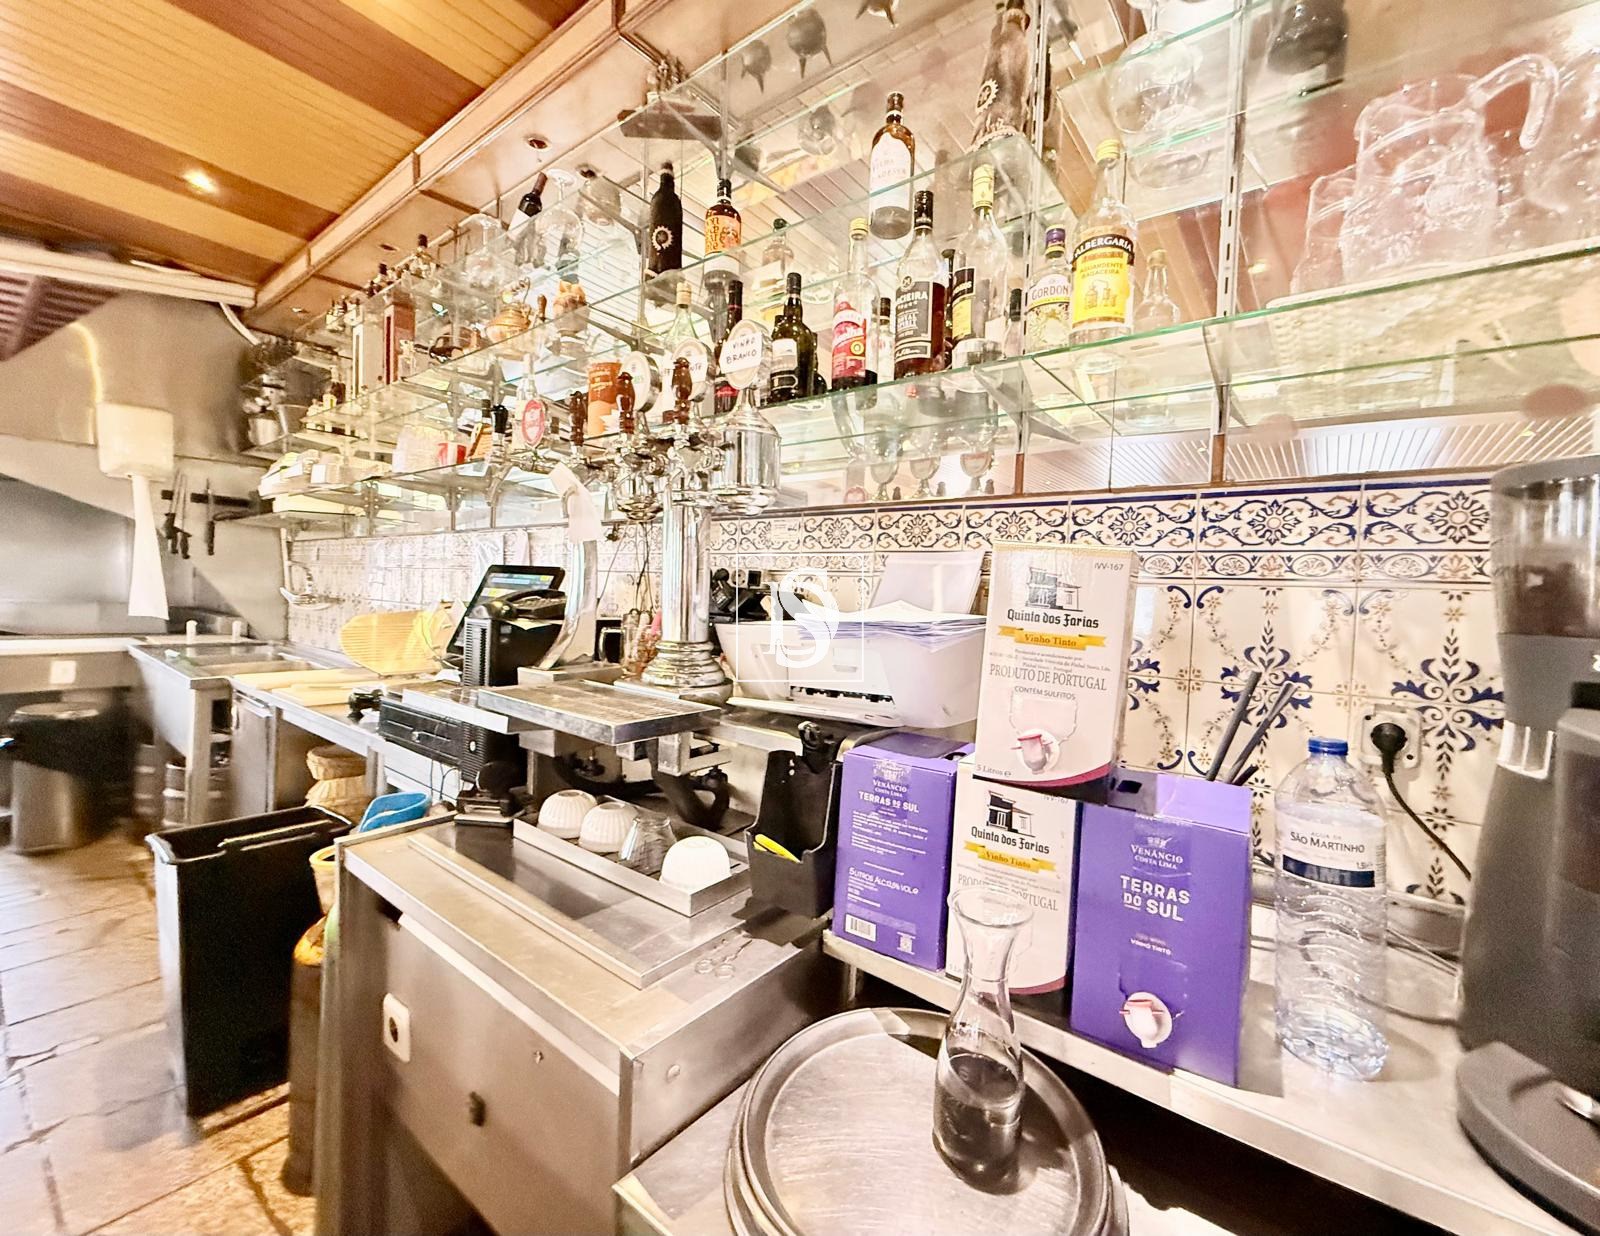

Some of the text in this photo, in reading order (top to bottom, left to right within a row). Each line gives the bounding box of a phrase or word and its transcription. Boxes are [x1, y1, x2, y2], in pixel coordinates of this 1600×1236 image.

[1074, 237, 1132, 257] ALBERGARIA
[726, 349, 757, 364] BRANCO
[1007, 608, 1099, 629] Quinta dos Farias
[1024, 634, 1077, 647] Vinho Tinto
[989, 664, 1107, 690] PRODUTO DE PORTUGAL
[1043, 689, 1076, 700] SULFITOS
[982, 765, 1005, 775] Litros
[872, 779, 907, 793] VENÂNCIO
[859, 791, 891, 806] TERRAS
[902, 802, 919, 813] SUL
[971, 826, 1050, 854] Quinta dos Farias
[1309, 836, 1365, 853] MARTINHO
[985, 851, 1031, 869] Vinho Tinto
[1130, 844, 1184, 864] VENÂNCIO
[1134, 854, 1178, 870] COSTA LIMA
[1120, 875, 1191, 905] TERRAS
[1123, 892, 1184, 922] DO SUL
